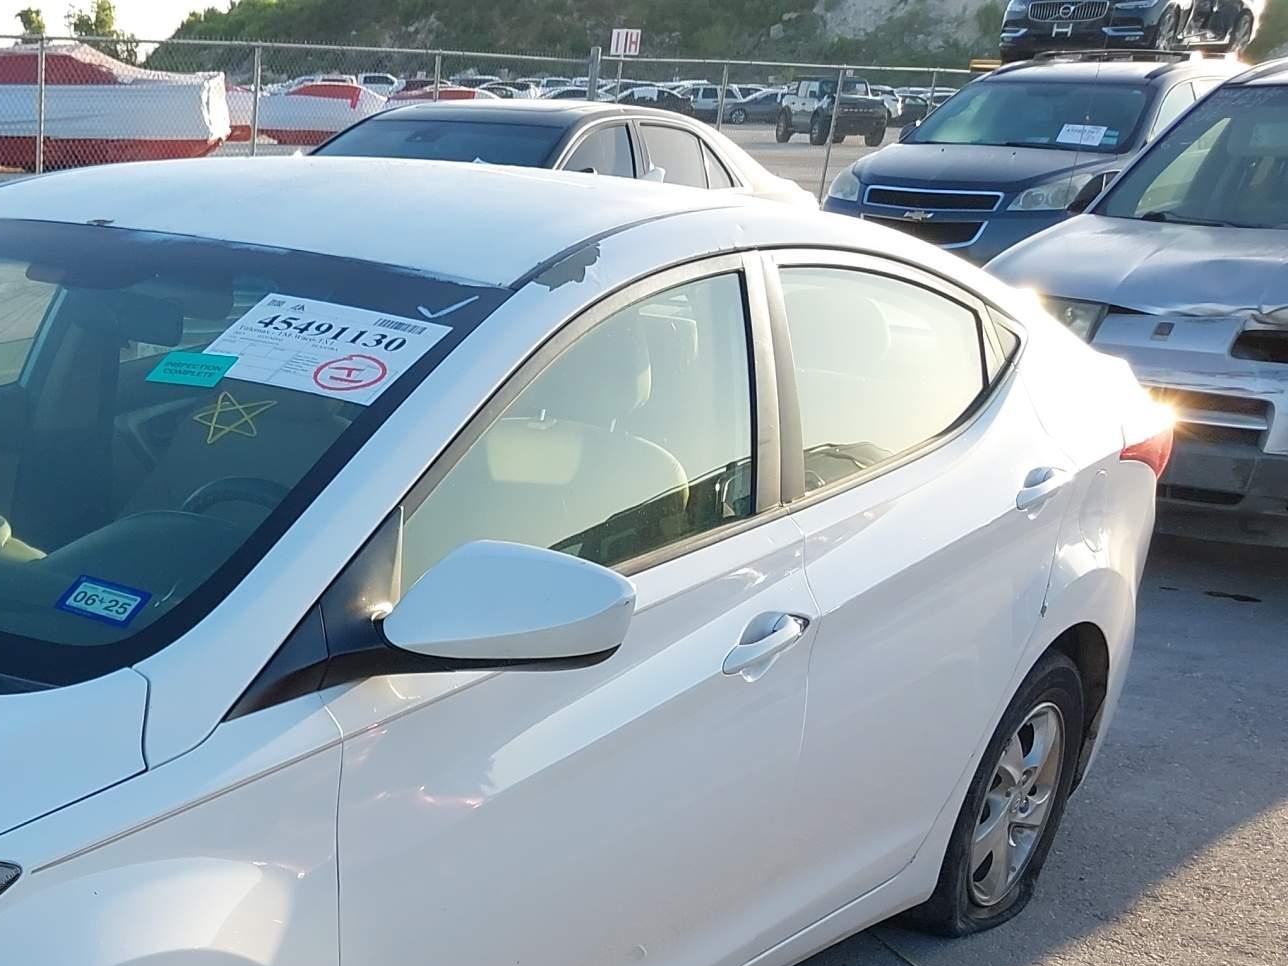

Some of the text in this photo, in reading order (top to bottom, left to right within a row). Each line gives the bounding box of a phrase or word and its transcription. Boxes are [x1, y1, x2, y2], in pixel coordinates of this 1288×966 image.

[256, 314, 408, 352] 45491130
[163, 367, 216, 378] COMPLETE
[165, 361, 223, 372] INSPECTION
[73, 590, 133, 615] 06 25
